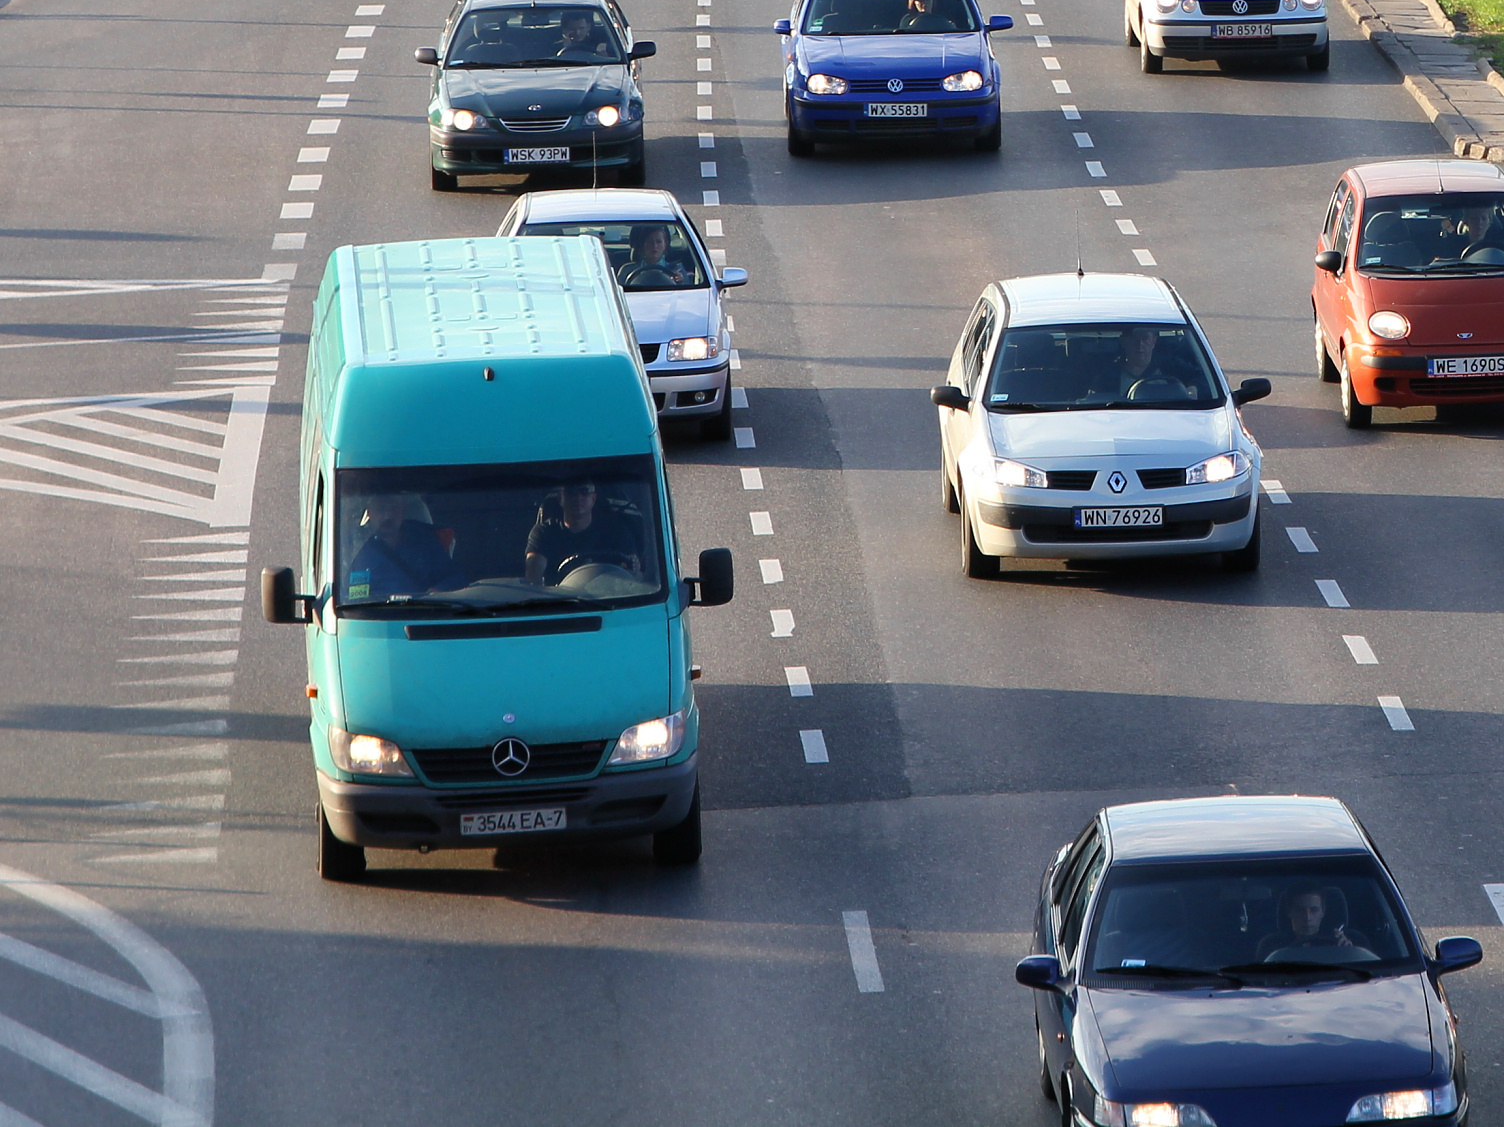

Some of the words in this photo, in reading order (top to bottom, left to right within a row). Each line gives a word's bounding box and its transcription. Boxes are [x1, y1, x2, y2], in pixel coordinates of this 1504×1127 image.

[1218, 25, 1234, 36] WB
[1237, 25, 1271, 36] 85916
[870, 105, 887, 116] WX
[890, 104, 926, 116] 55831
[510, 148, 537, 162] WSK
[538, 147, 568, 161] 93PW
[1436, 360, 1456, 373] WE
[1083, 510, 1107, 526] WN
[1111, 508, 1162, 525] 76926
[477, 814, 516, 832] 3544
[520, 810, 563, 829] EA-7
